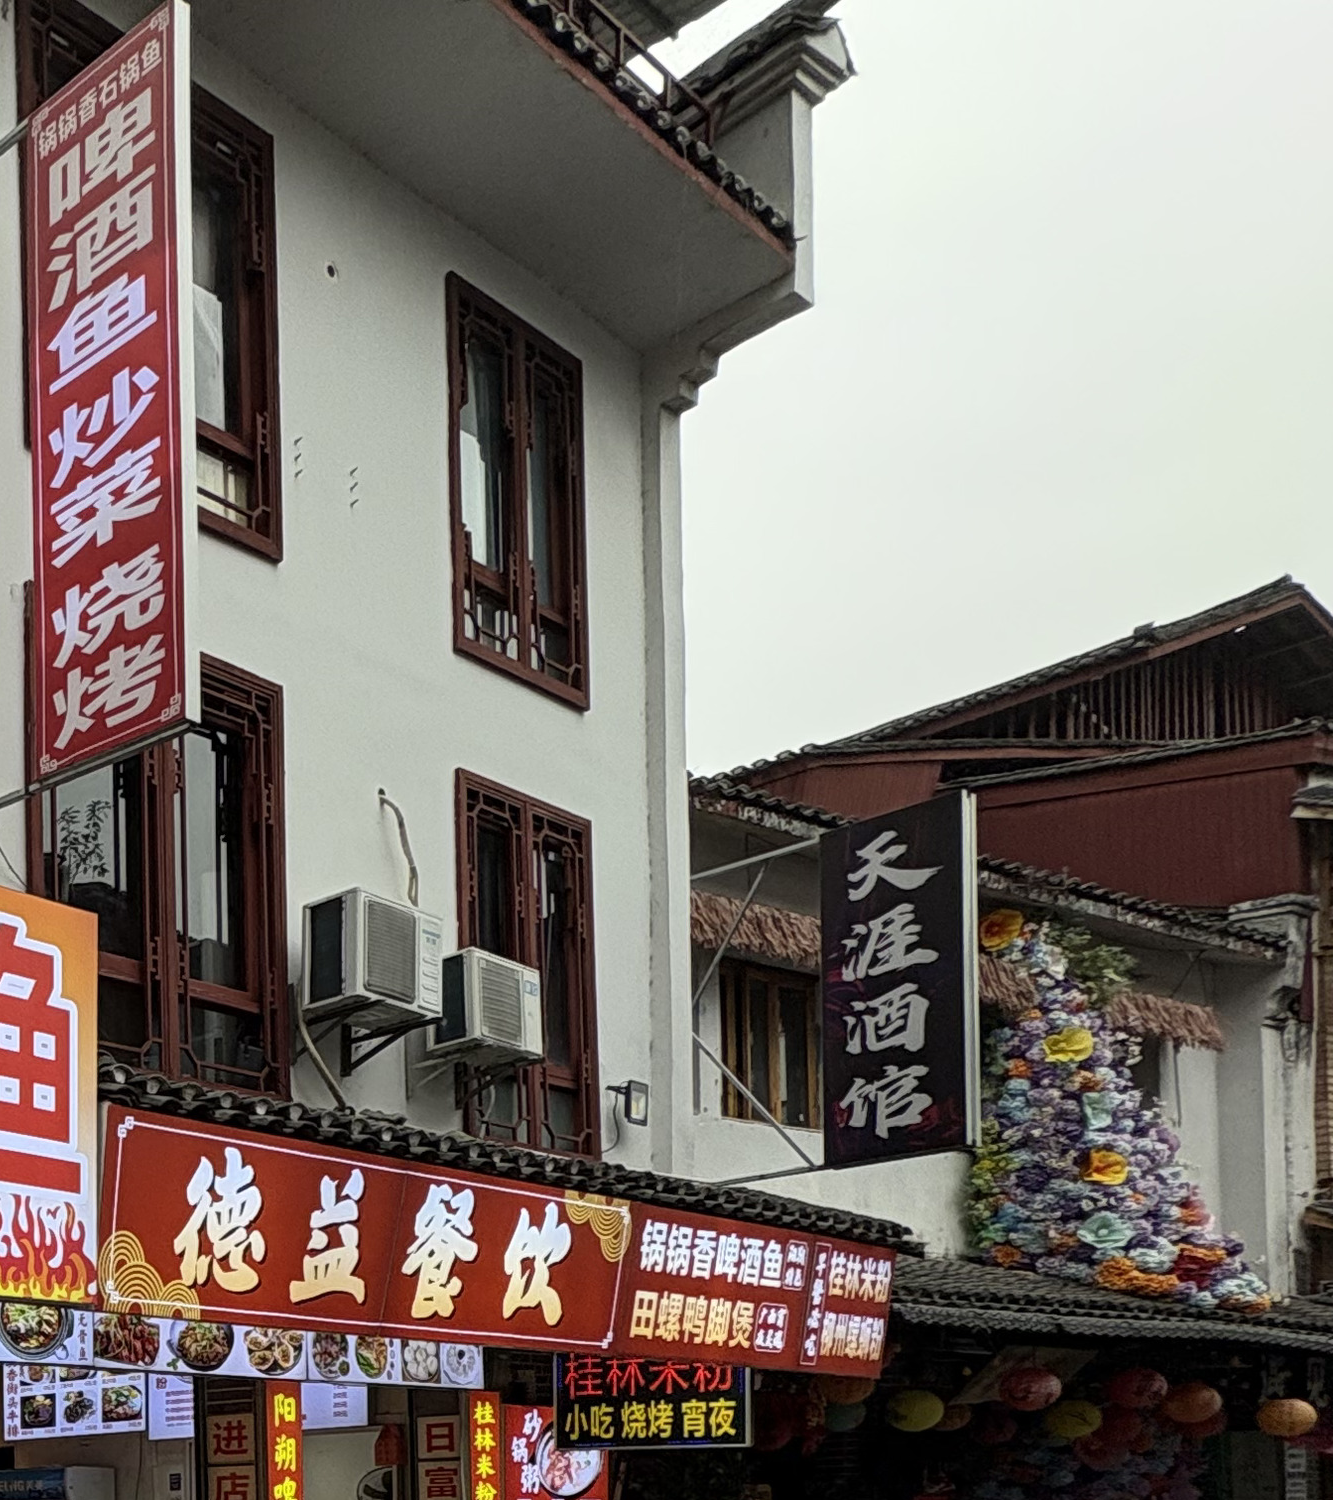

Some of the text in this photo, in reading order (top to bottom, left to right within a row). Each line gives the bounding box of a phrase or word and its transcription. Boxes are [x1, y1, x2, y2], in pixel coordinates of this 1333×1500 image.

[38, 38, 162, 160] 锅锅香石锅鱼
[840, 830, 944, 1140] 天涯酒馆
[174, 1147, 573, 1327] 德益餐饮
[640, 1219, 785, 1289] 锅锅香啤酒鱼
[827, 1250, 892, 1303] 桂林米粉
[629, 1290, 756, 1350] 田螺鸭脚煲
[565, 1397, 737, 1440] 小吃 烧烤 宵夜
